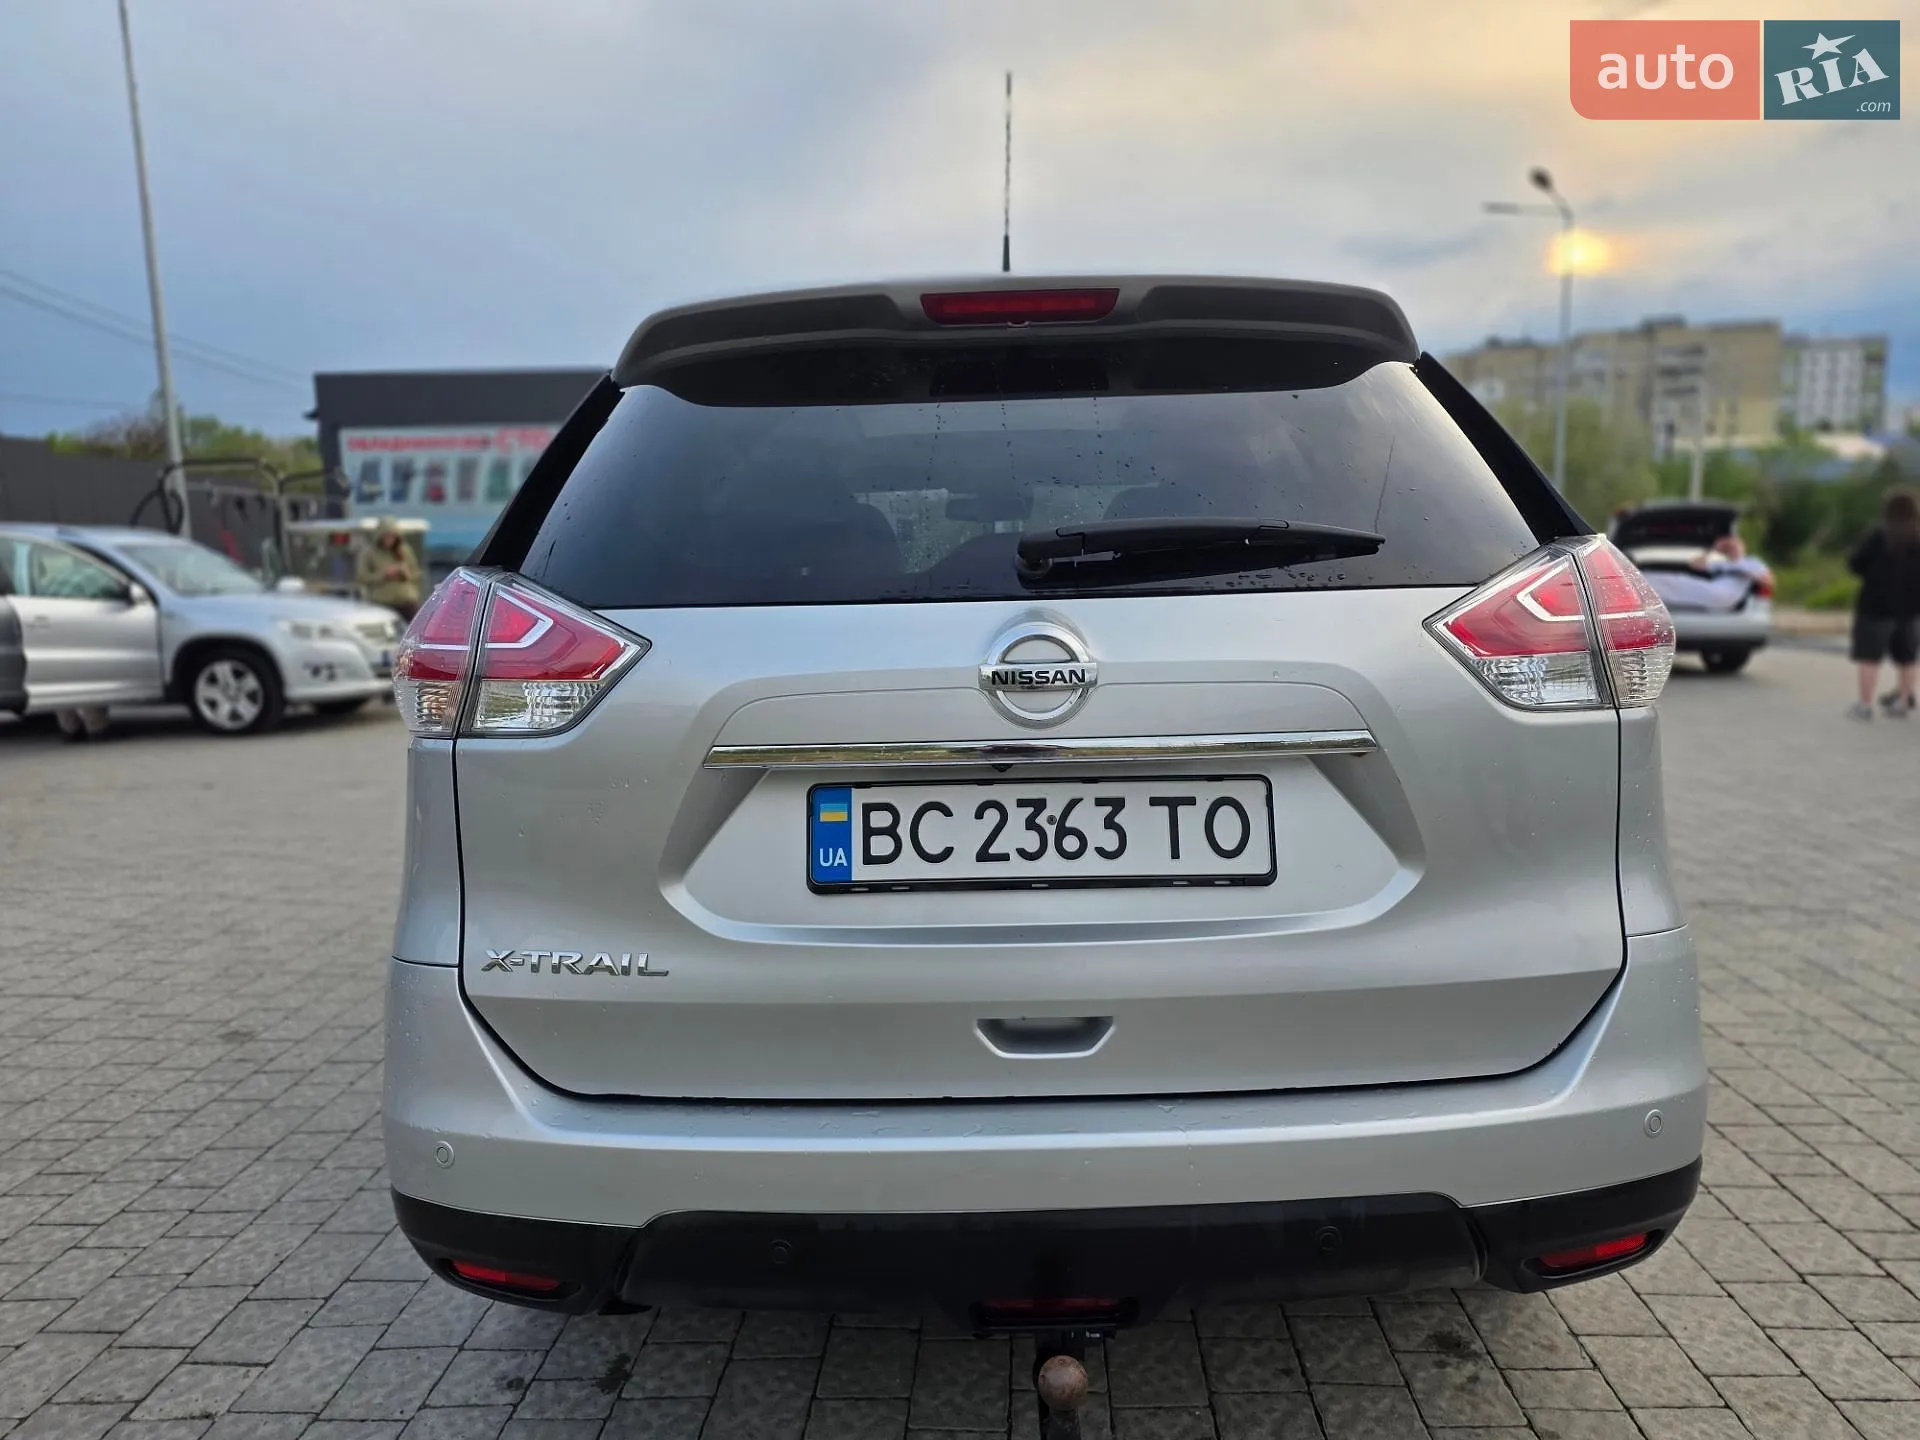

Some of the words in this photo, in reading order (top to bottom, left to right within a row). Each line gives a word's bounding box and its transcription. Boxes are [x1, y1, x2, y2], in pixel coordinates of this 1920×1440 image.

[991, 669, 1086, 685] NISSAN
[862, 800, 955, 865] BC
[974, 797, 1128, 863] 2363
[1149, 796, 1251, 860] TO
[819, 847, 848, 867] UA
[481, 949, 670, 977] X-TRAIL
